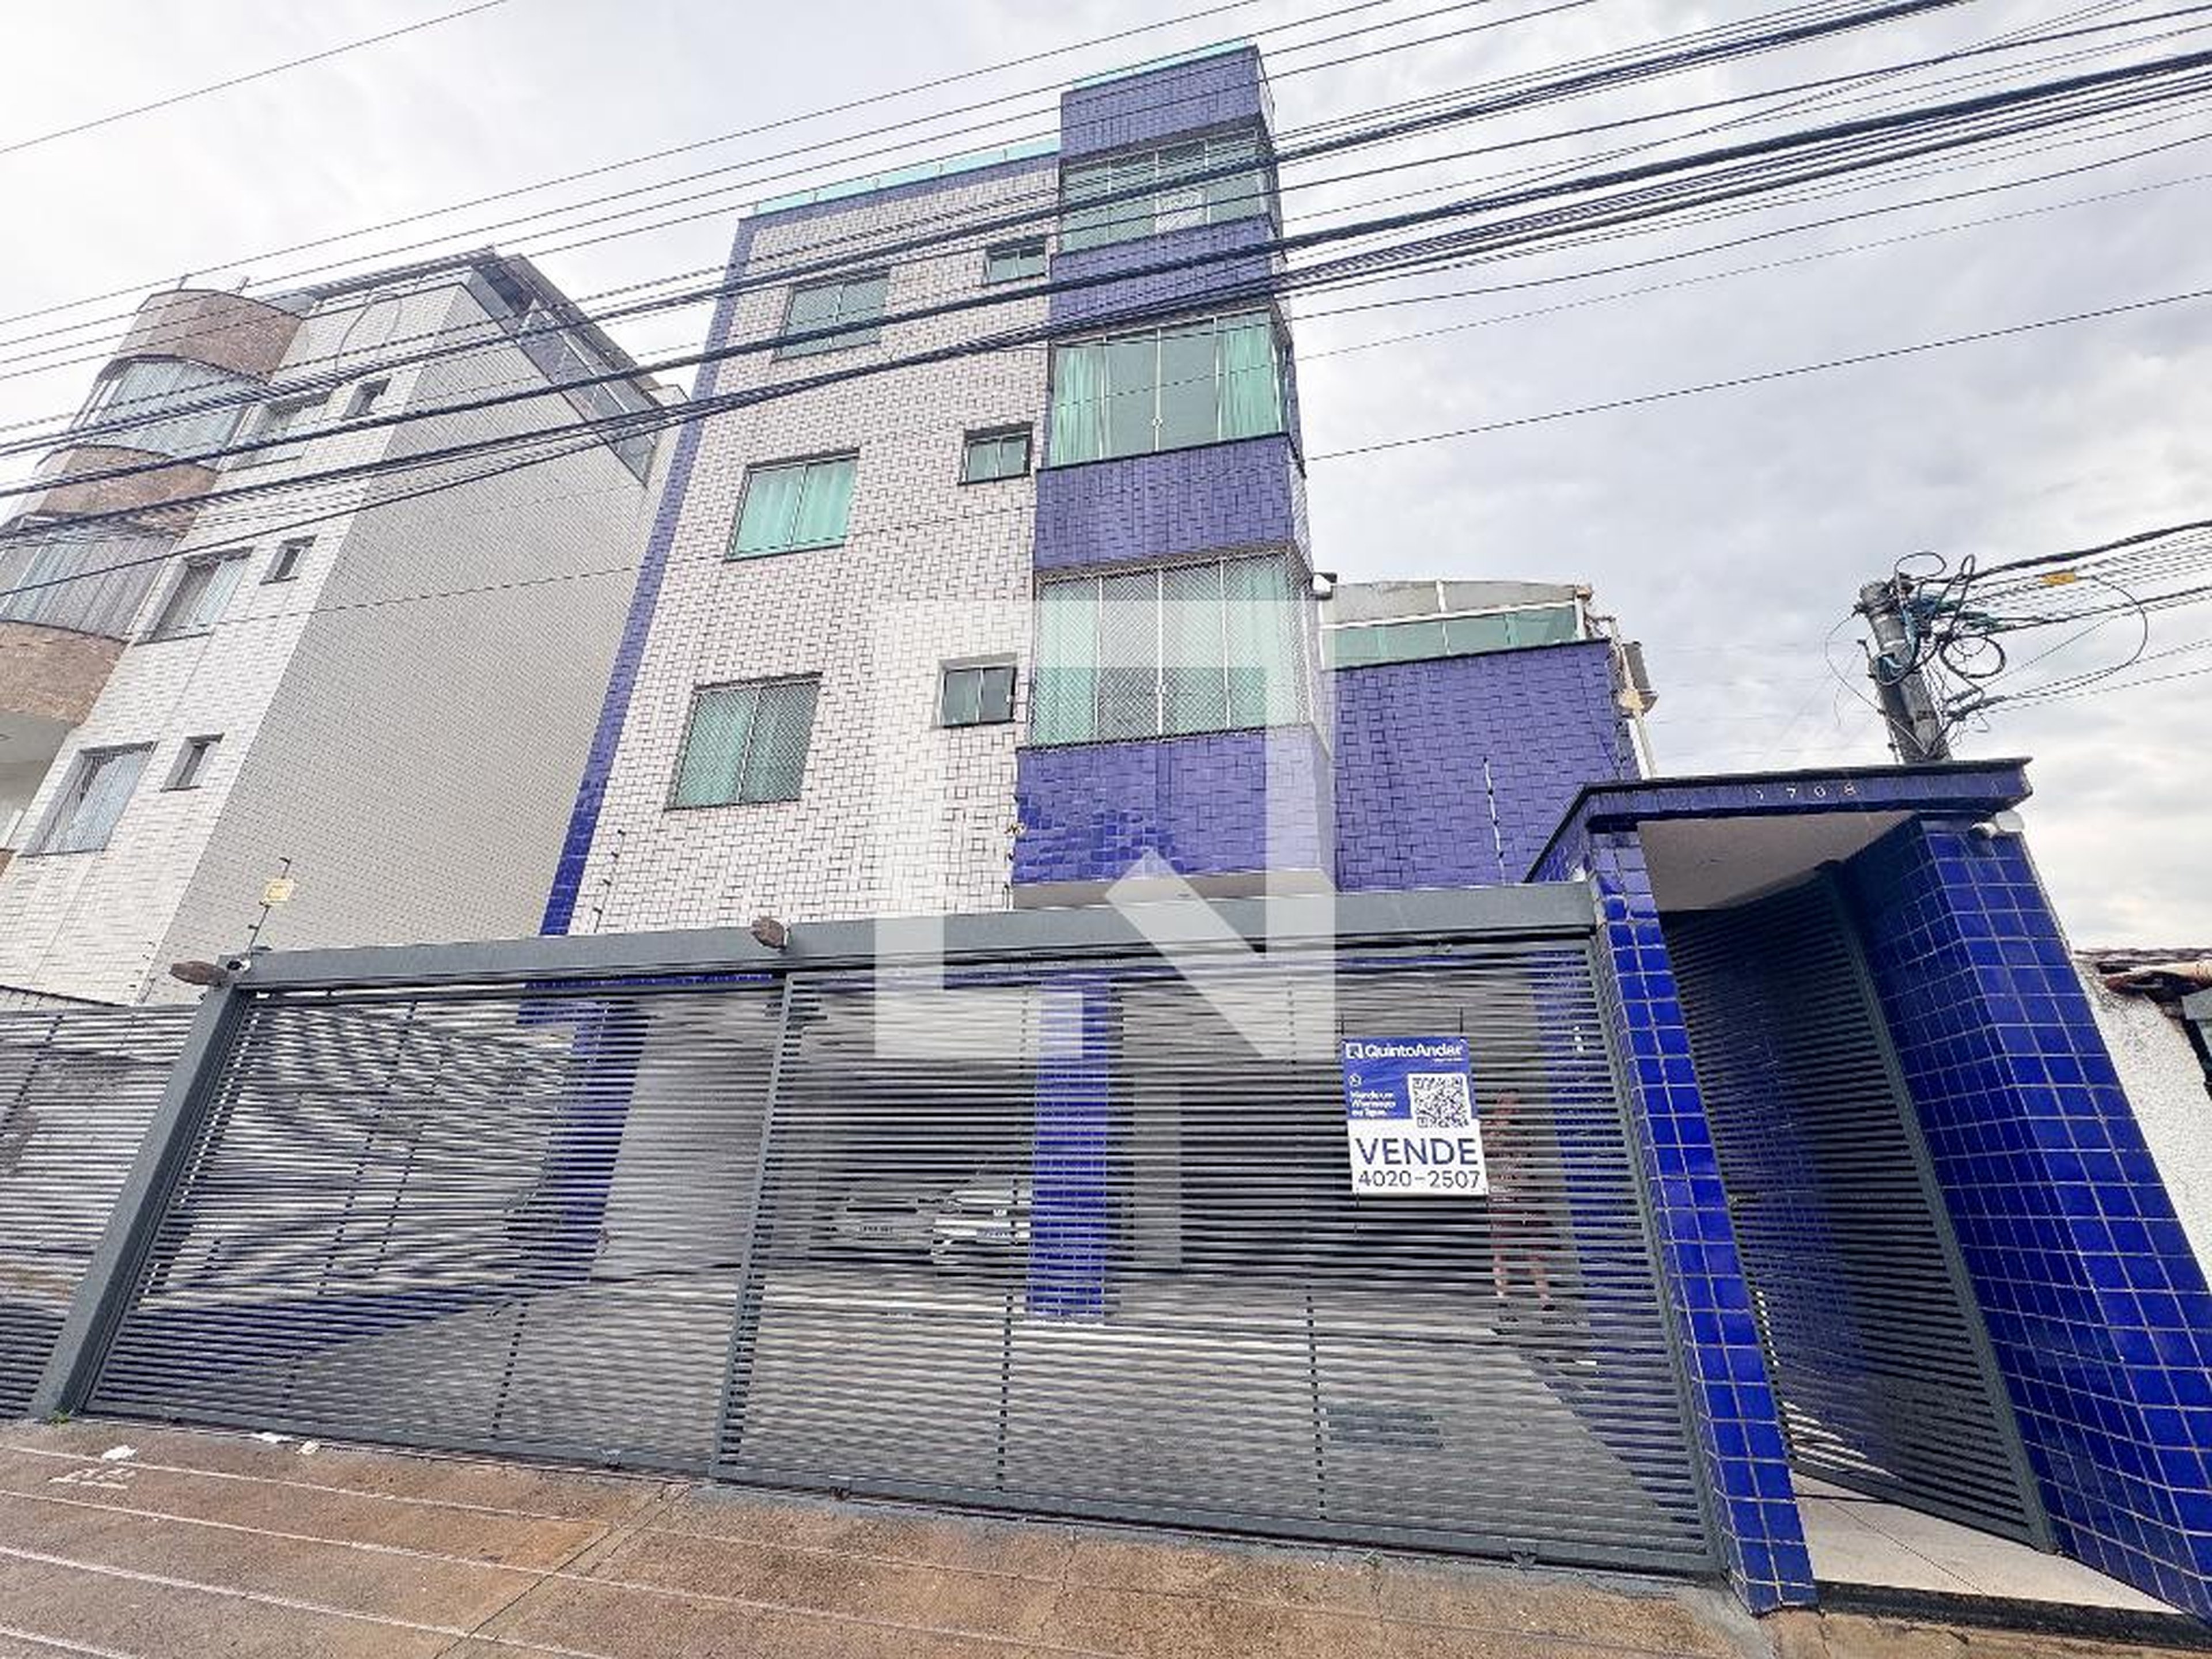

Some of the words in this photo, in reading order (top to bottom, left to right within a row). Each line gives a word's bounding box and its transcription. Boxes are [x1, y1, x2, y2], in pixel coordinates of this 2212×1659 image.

[1756, 783, 1856, 800] 1708
[1355, 1138, 1478, 1165] VENDE
[1358, 1170, 1480, 1188] 4020-2507
